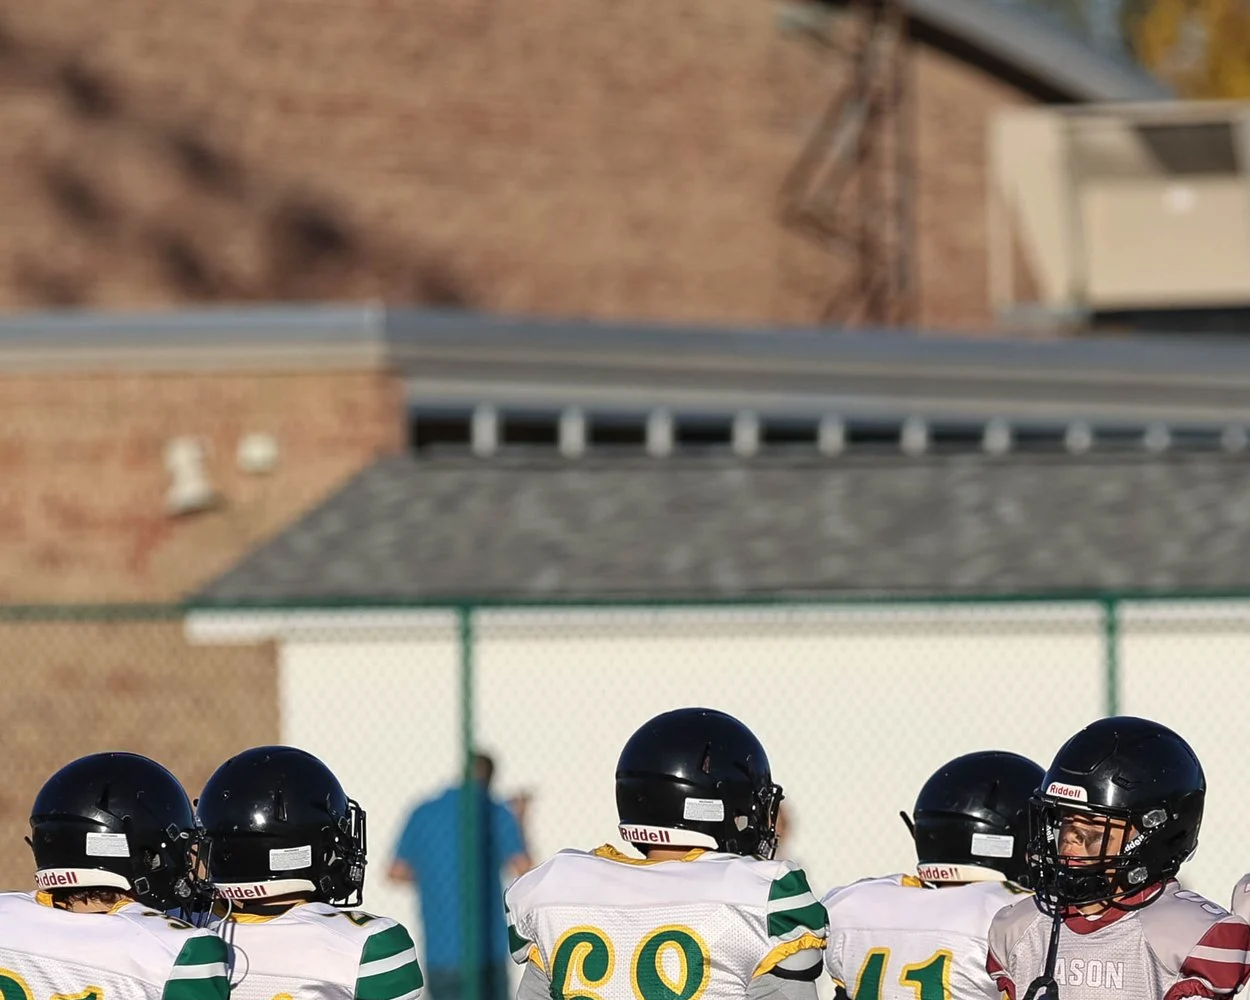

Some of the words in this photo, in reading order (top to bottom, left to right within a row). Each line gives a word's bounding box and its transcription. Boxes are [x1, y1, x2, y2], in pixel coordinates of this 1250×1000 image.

[1049, 784, 1081, 798] Riddell
[620, 828, 670, 843] Riddell
[1054, 958, 1125, 989] ASON
